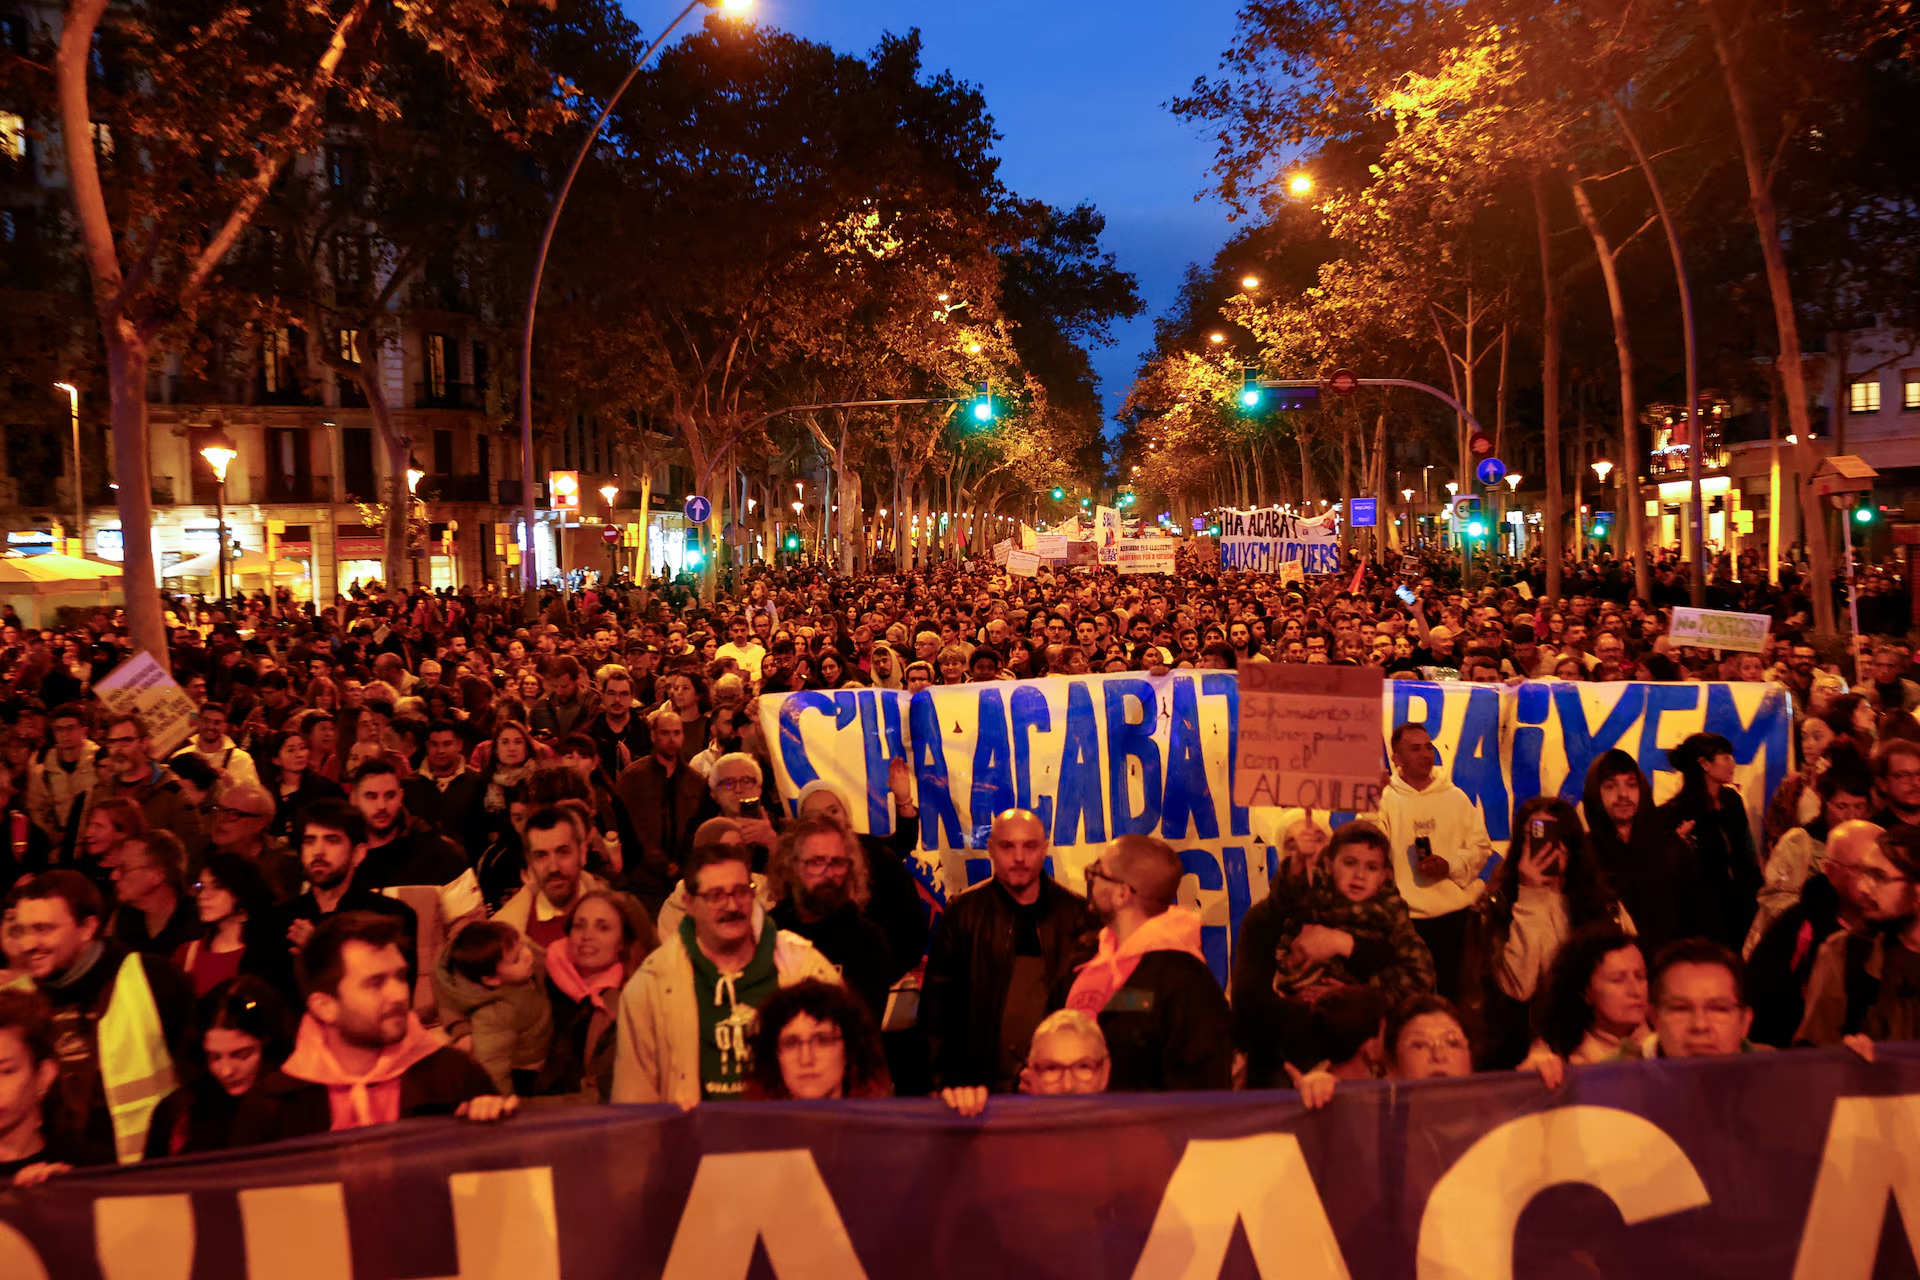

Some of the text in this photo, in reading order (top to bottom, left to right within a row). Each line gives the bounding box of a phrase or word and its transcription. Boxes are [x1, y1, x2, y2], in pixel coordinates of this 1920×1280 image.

[1248, 511, 1301, 539] ACABAT
[1221, 542, 1271, 573] BAIXEM
[779, 687, 964, 852] S'HA
[972, 673, 1251, 851] ACABAT
[1249, 772, 1381, 812] ALQUILER
[0, 1148, 867, 1280] 'HA
